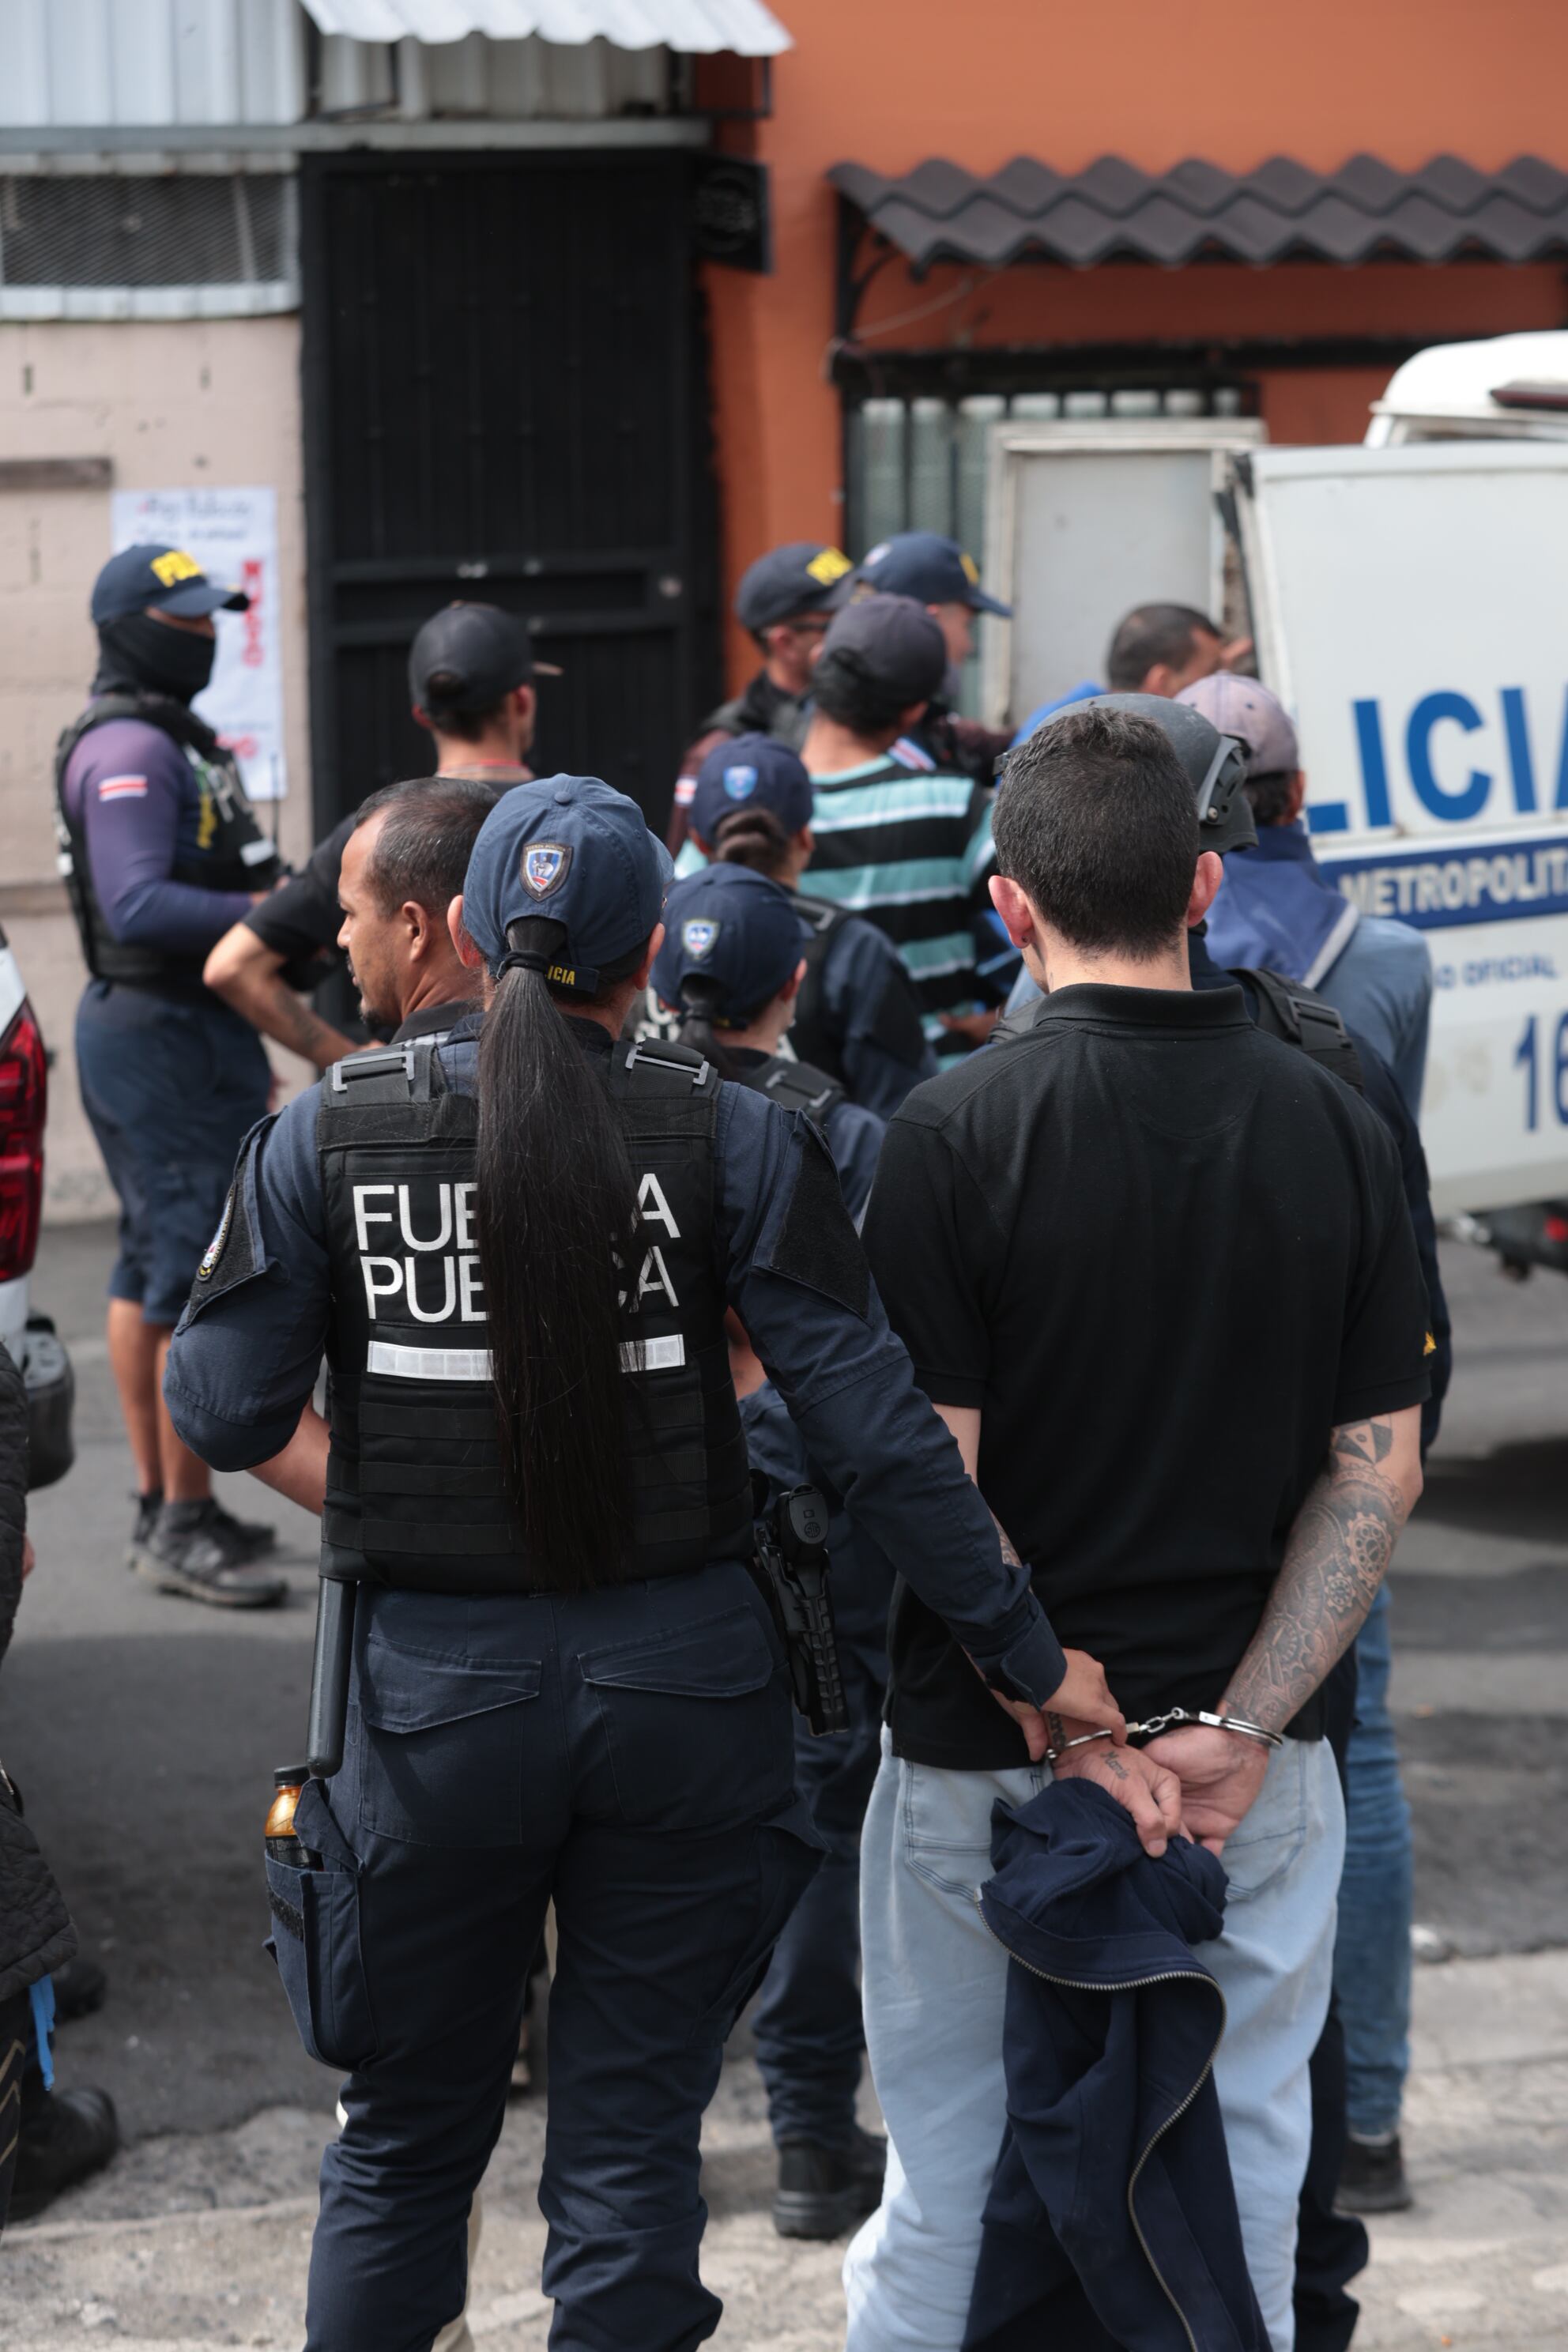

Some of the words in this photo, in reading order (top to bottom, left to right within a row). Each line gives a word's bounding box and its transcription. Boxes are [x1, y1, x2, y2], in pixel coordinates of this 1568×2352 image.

[1338, 847, 1568, 917] METROPOLIT
[545, 964, 575, 986] ICIA
[1464, 952, 1557, 987] OFICIAL
[353, 1173, 681, 1250] FUEA
